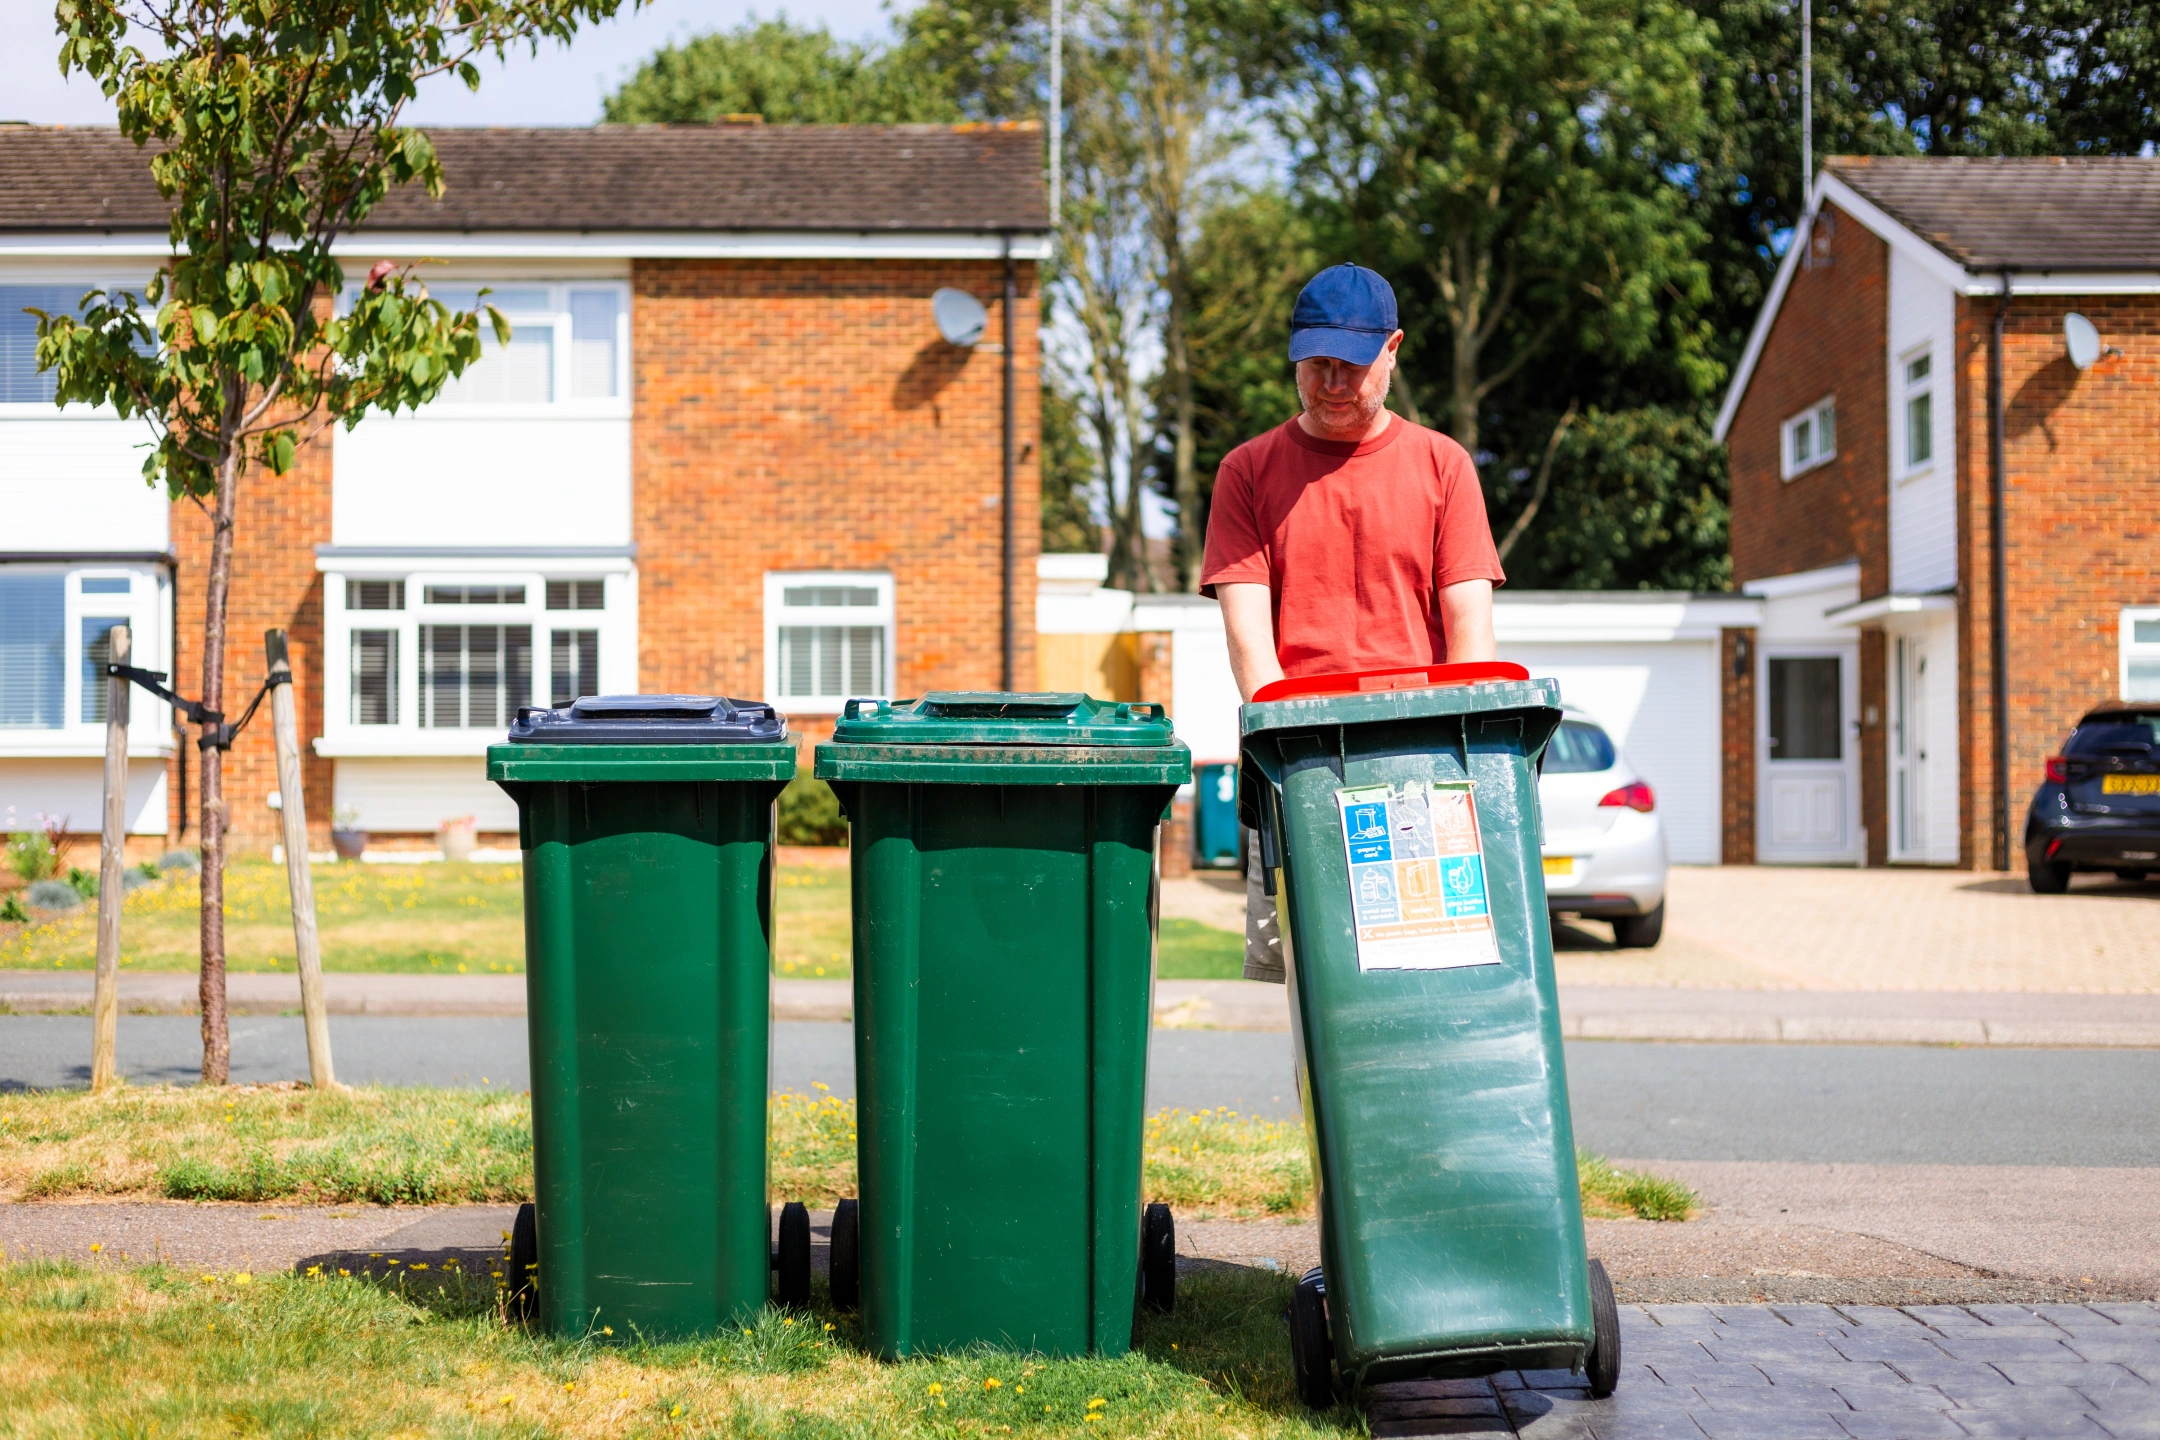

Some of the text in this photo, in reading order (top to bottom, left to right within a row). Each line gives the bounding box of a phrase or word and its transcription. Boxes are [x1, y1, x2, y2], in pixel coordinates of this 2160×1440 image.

[1357, 846, 1377, 855] paper
[1447, 900, 1463, 908] glass
[1361, 907, 1379, 915] metal
[1384, 930, 1403, 938] plastic
